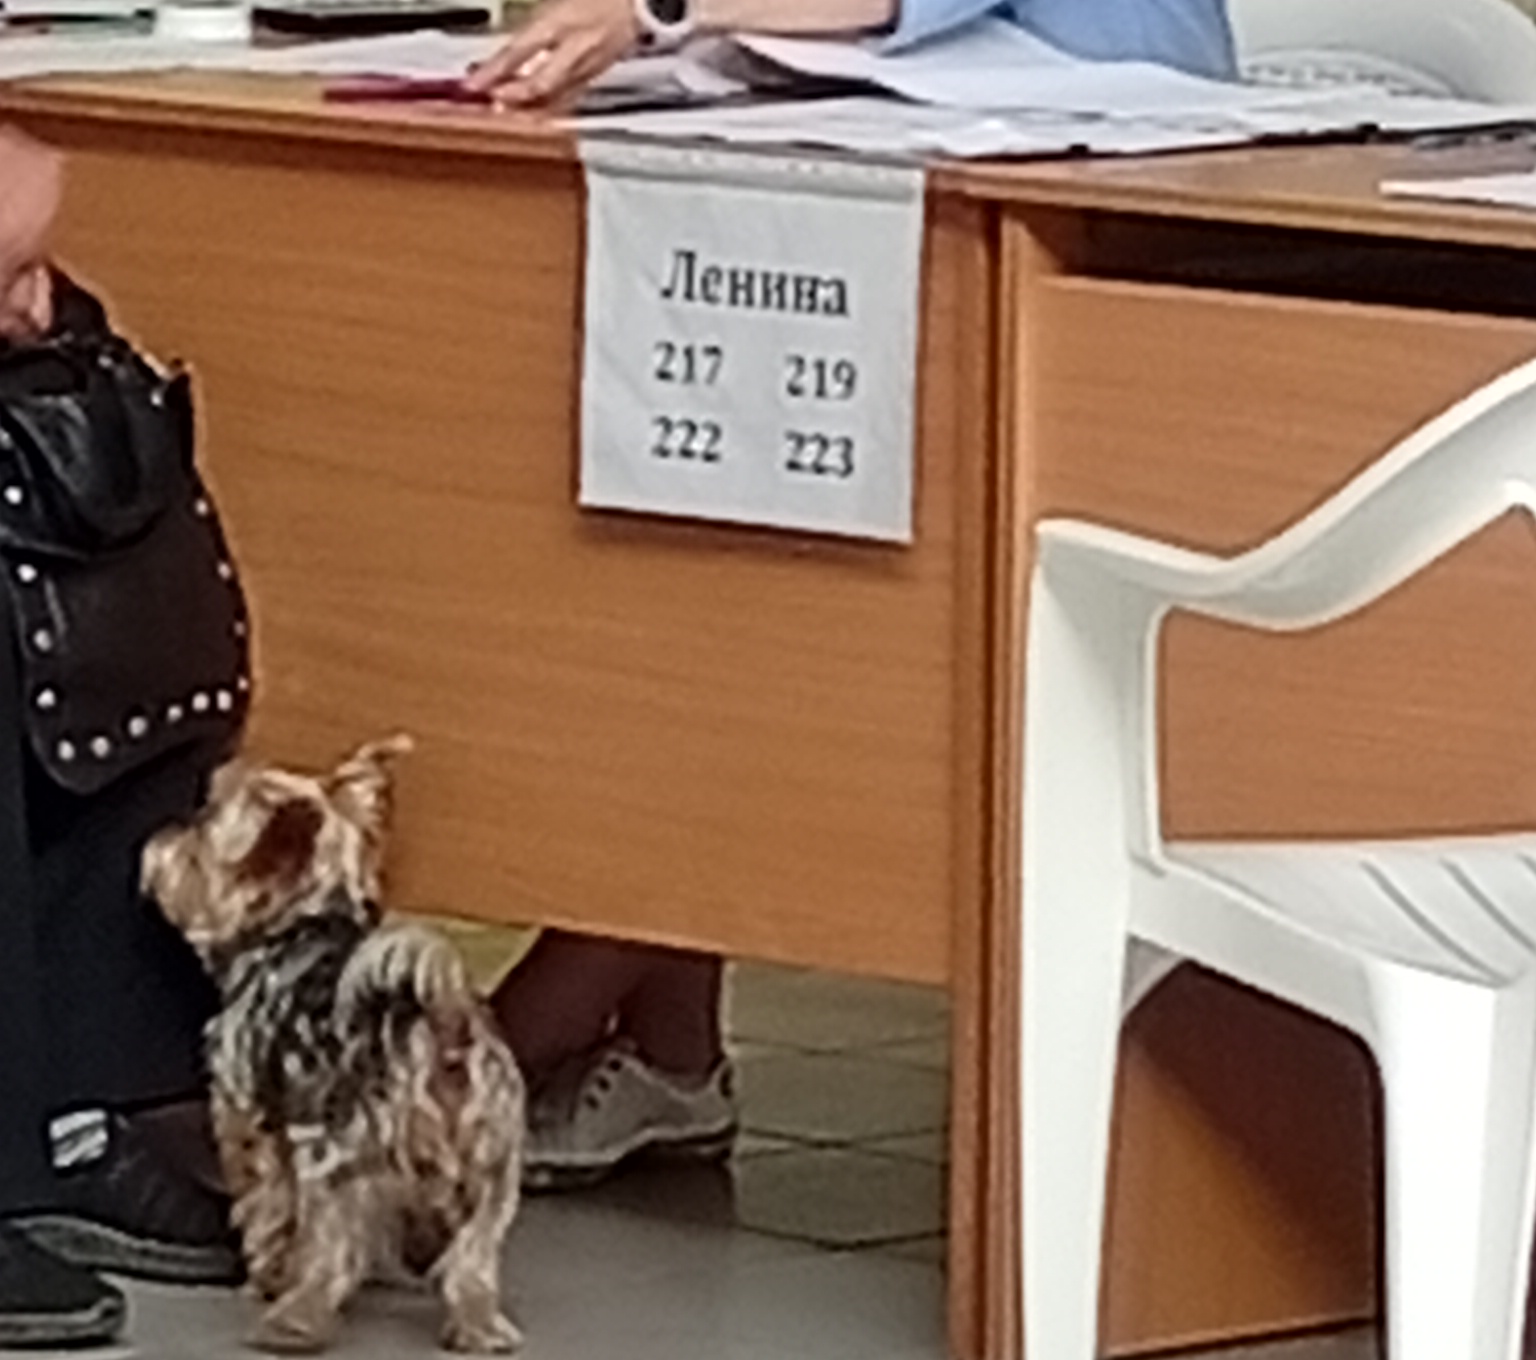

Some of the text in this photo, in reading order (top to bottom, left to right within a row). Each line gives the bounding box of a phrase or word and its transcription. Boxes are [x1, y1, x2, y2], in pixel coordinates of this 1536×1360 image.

[659, 248, 849, 318] Ленина
[653, 340, 857, 401] 217 219
[650, 414, 856, 479] 222 223
